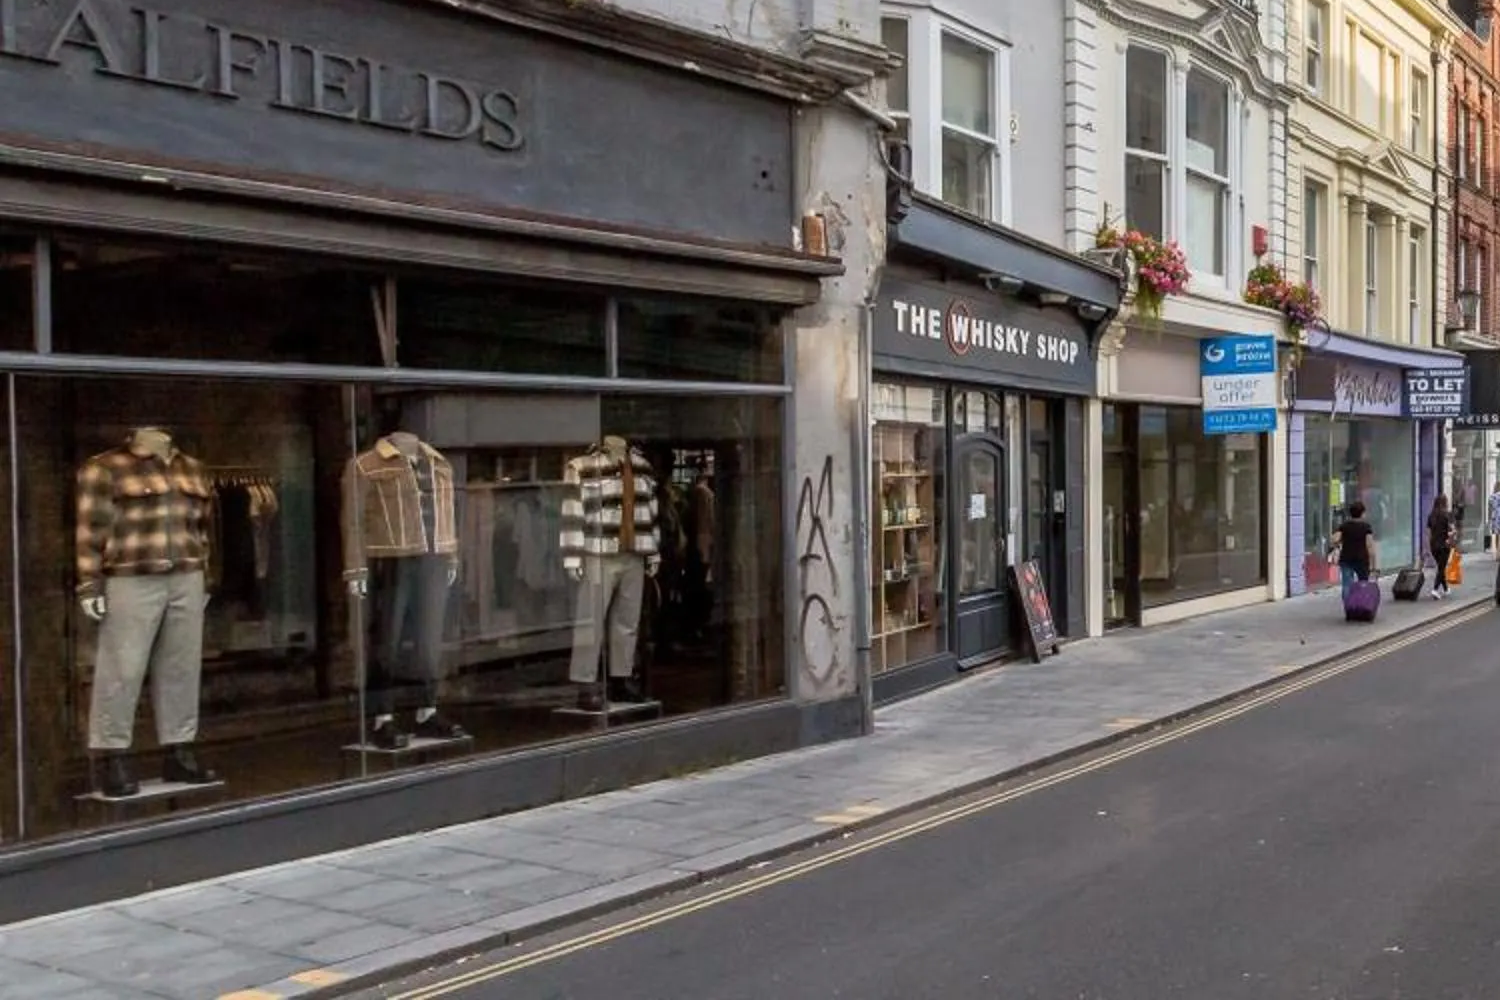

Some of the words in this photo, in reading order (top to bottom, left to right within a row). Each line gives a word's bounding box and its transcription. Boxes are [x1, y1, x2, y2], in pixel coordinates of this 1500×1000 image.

[893, 300, 941, 339] THE
[951, 314, 1030, 356] WHISKY
[1037, 333, 1079, 365] SHOP
[1213, 378, 1262, 391] under
[1408, 379, 1429, 391] TO
[1433, 379, 1465, 391] LET
[1219, 389, 1256, 403] offer
